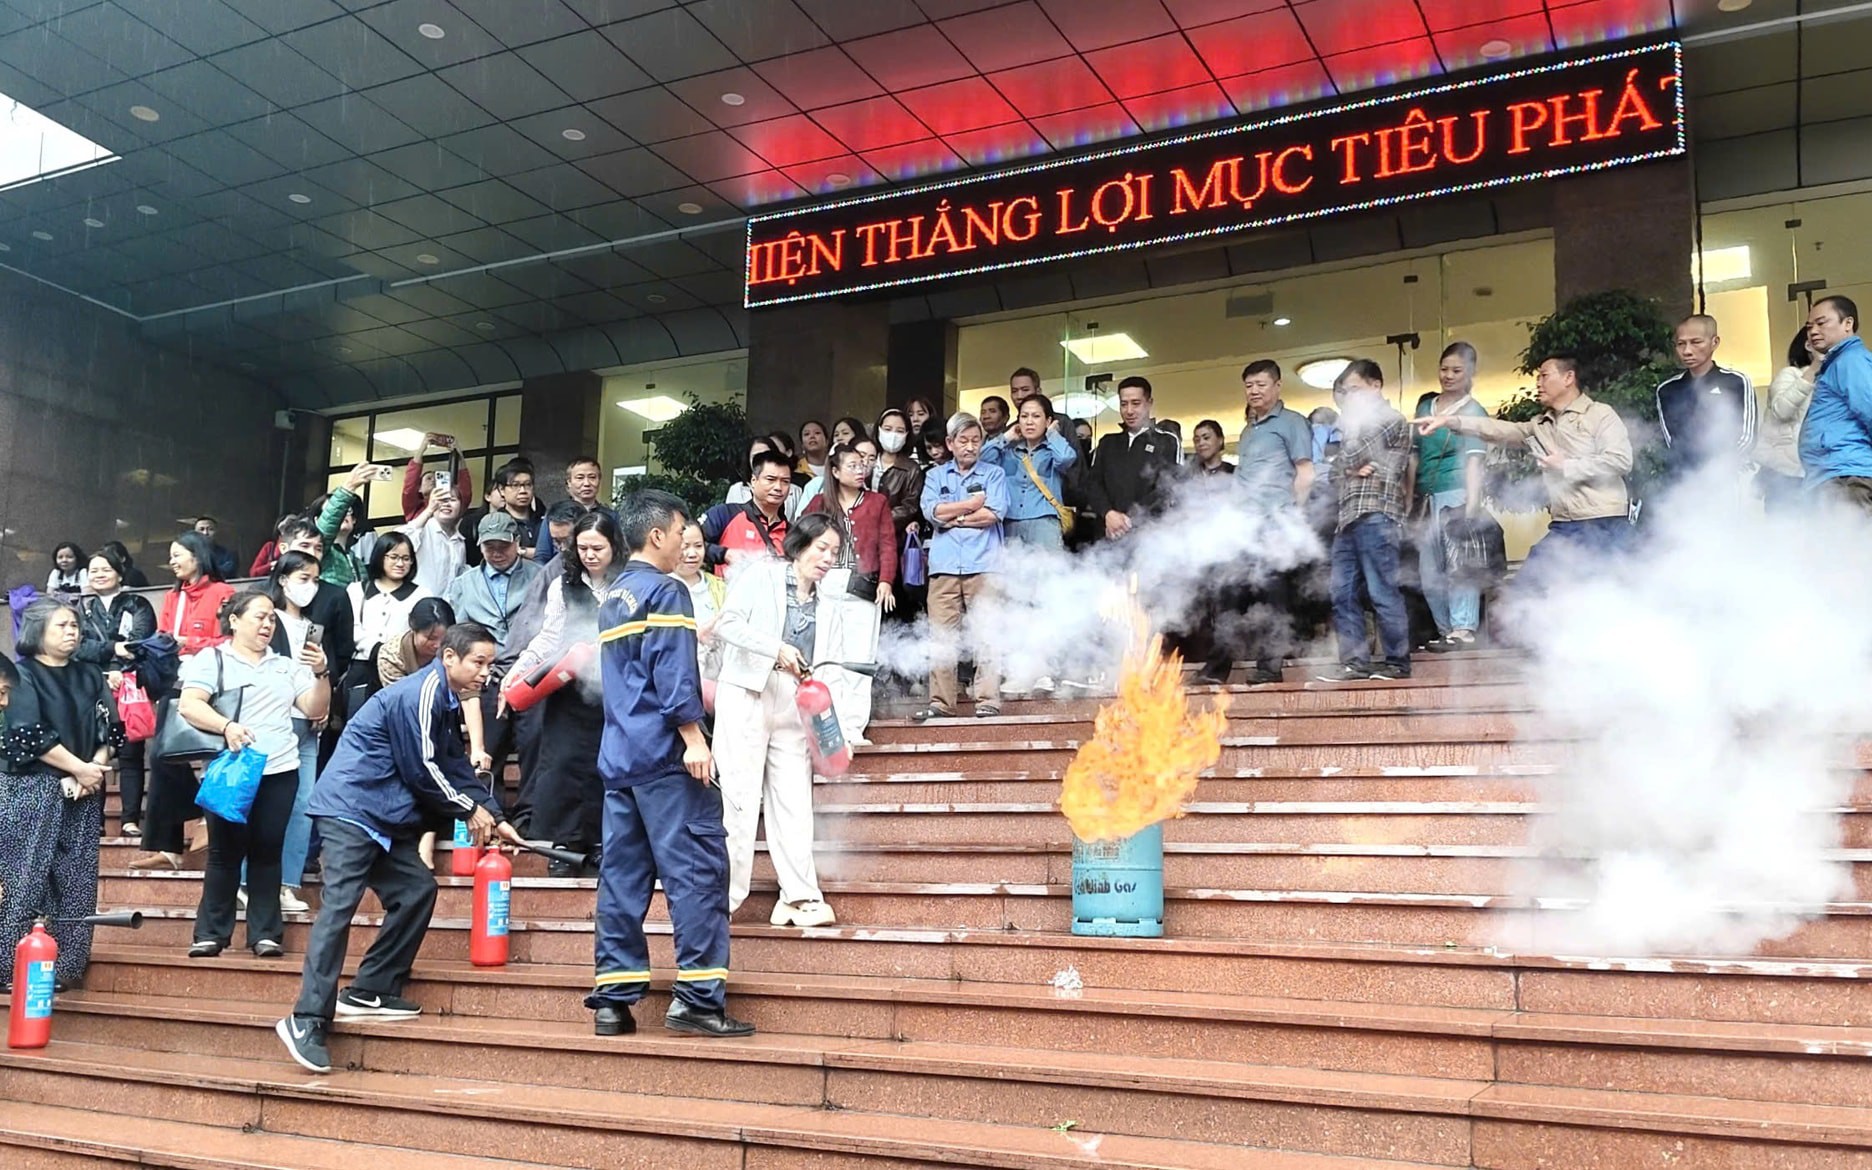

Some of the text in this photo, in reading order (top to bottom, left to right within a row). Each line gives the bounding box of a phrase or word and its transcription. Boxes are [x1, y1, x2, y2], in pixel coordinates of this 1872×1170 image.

[855, 197, 1042, 266] THẮNG
[1055, 173, 1154, 234] LỢI
[1170, 145, 1314, 213] MỤC
[1331, 108, 1491, 184] TIÊU
[1114, 879, 1137, 894] Gas
